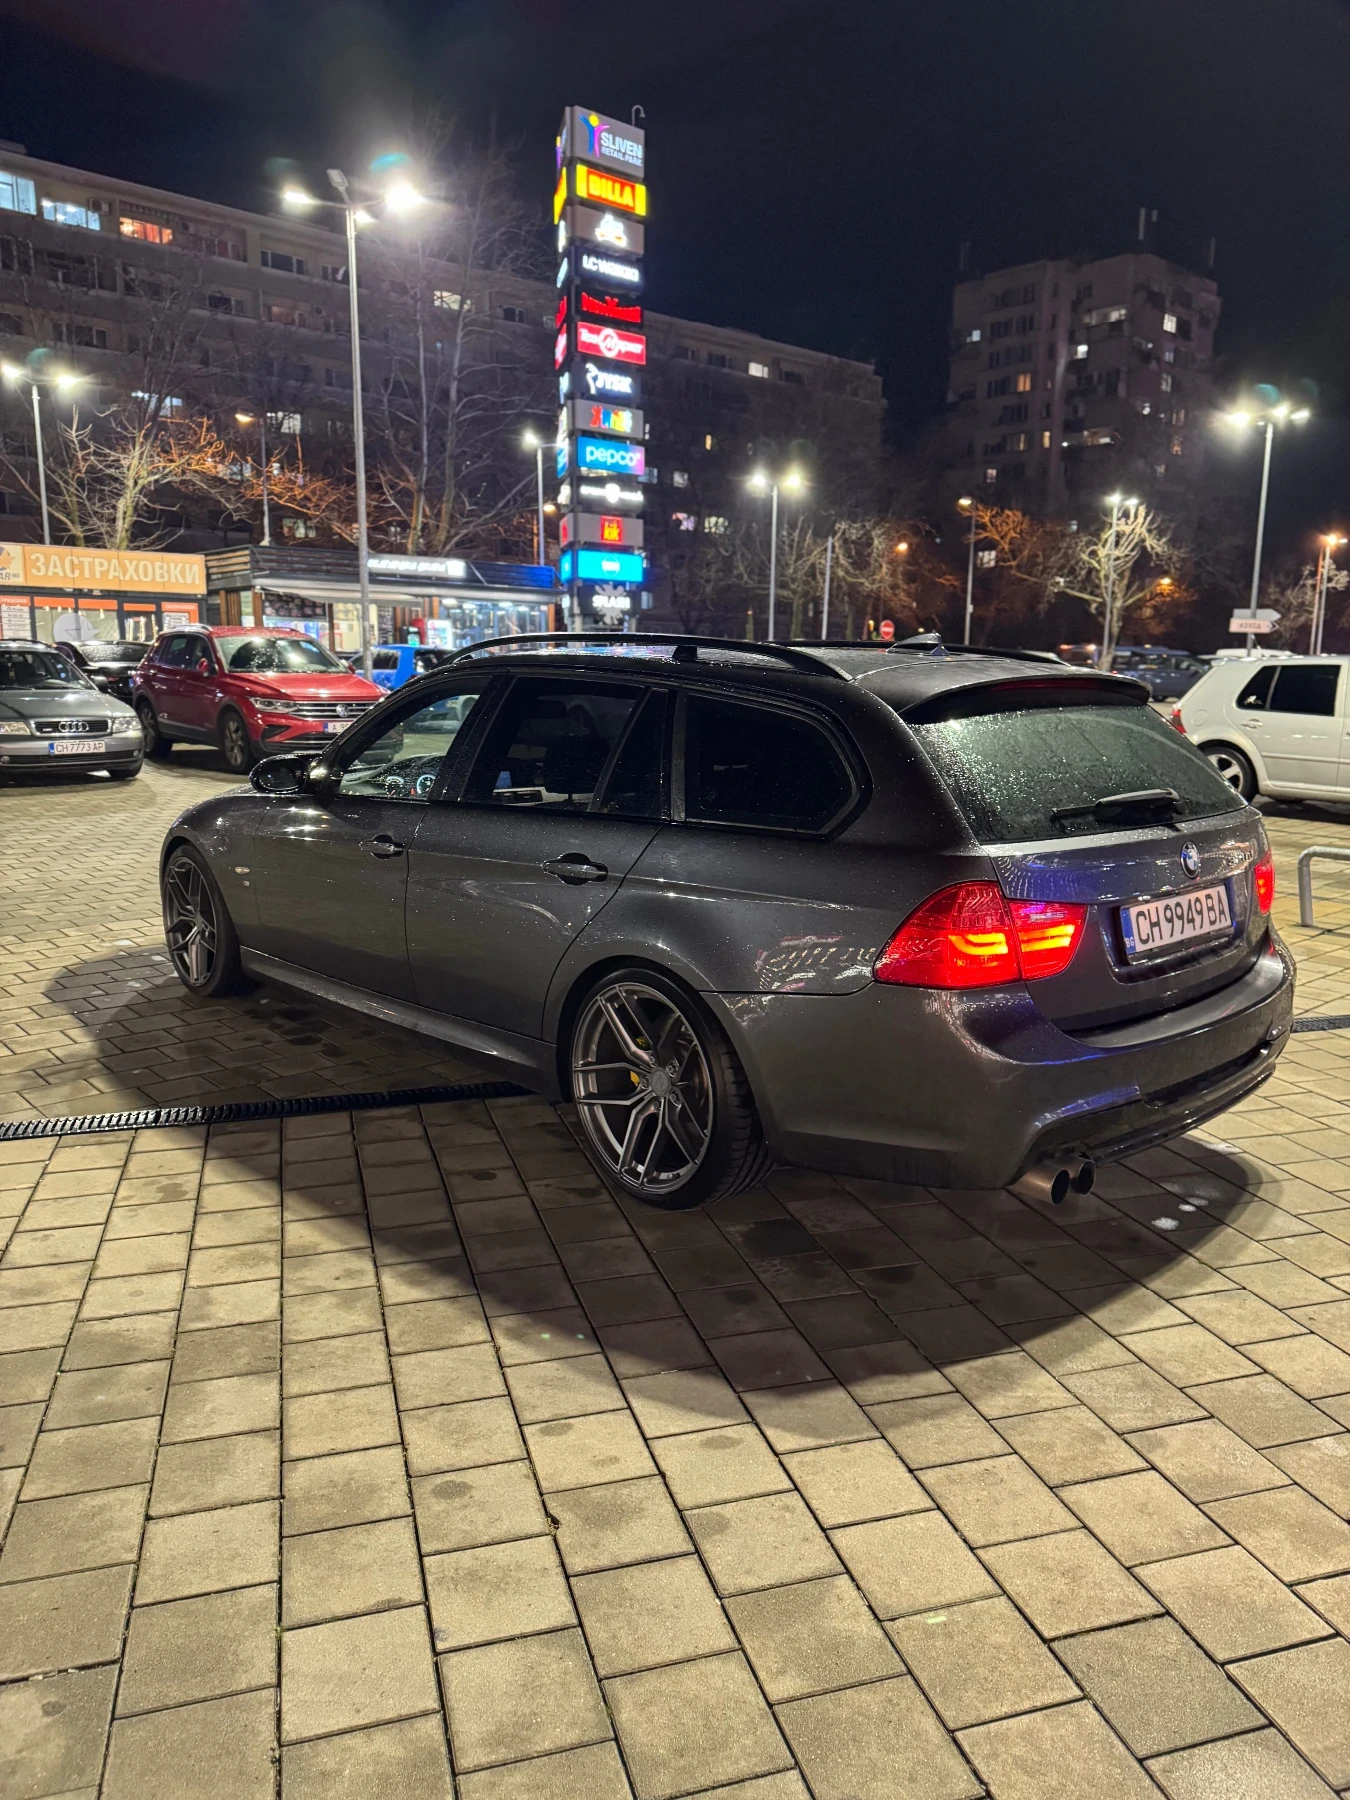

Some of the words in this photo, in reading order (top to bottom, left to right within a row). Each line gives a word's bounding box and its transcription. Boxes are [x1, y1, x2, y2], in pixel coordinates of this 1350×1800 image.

[600, 131, 643, 159] SLIVEN
[601, 146, 625, 162] RETAIL
[624, 152, 643, 167] PARK
[589, 175, 635, 207] BILLA
[585, 445, 637, 467] pepco
[30, 552, 200, 585] ЗАСТРАХОВКИ
[592, 595, 631, 609] SPLASH
[1135, 906, 1164, 945] CH
[1163, 896, 1204, 938] 9949
[1204, 890, 1228, 926] BA
[1125, 937, 1135, 947] BG
